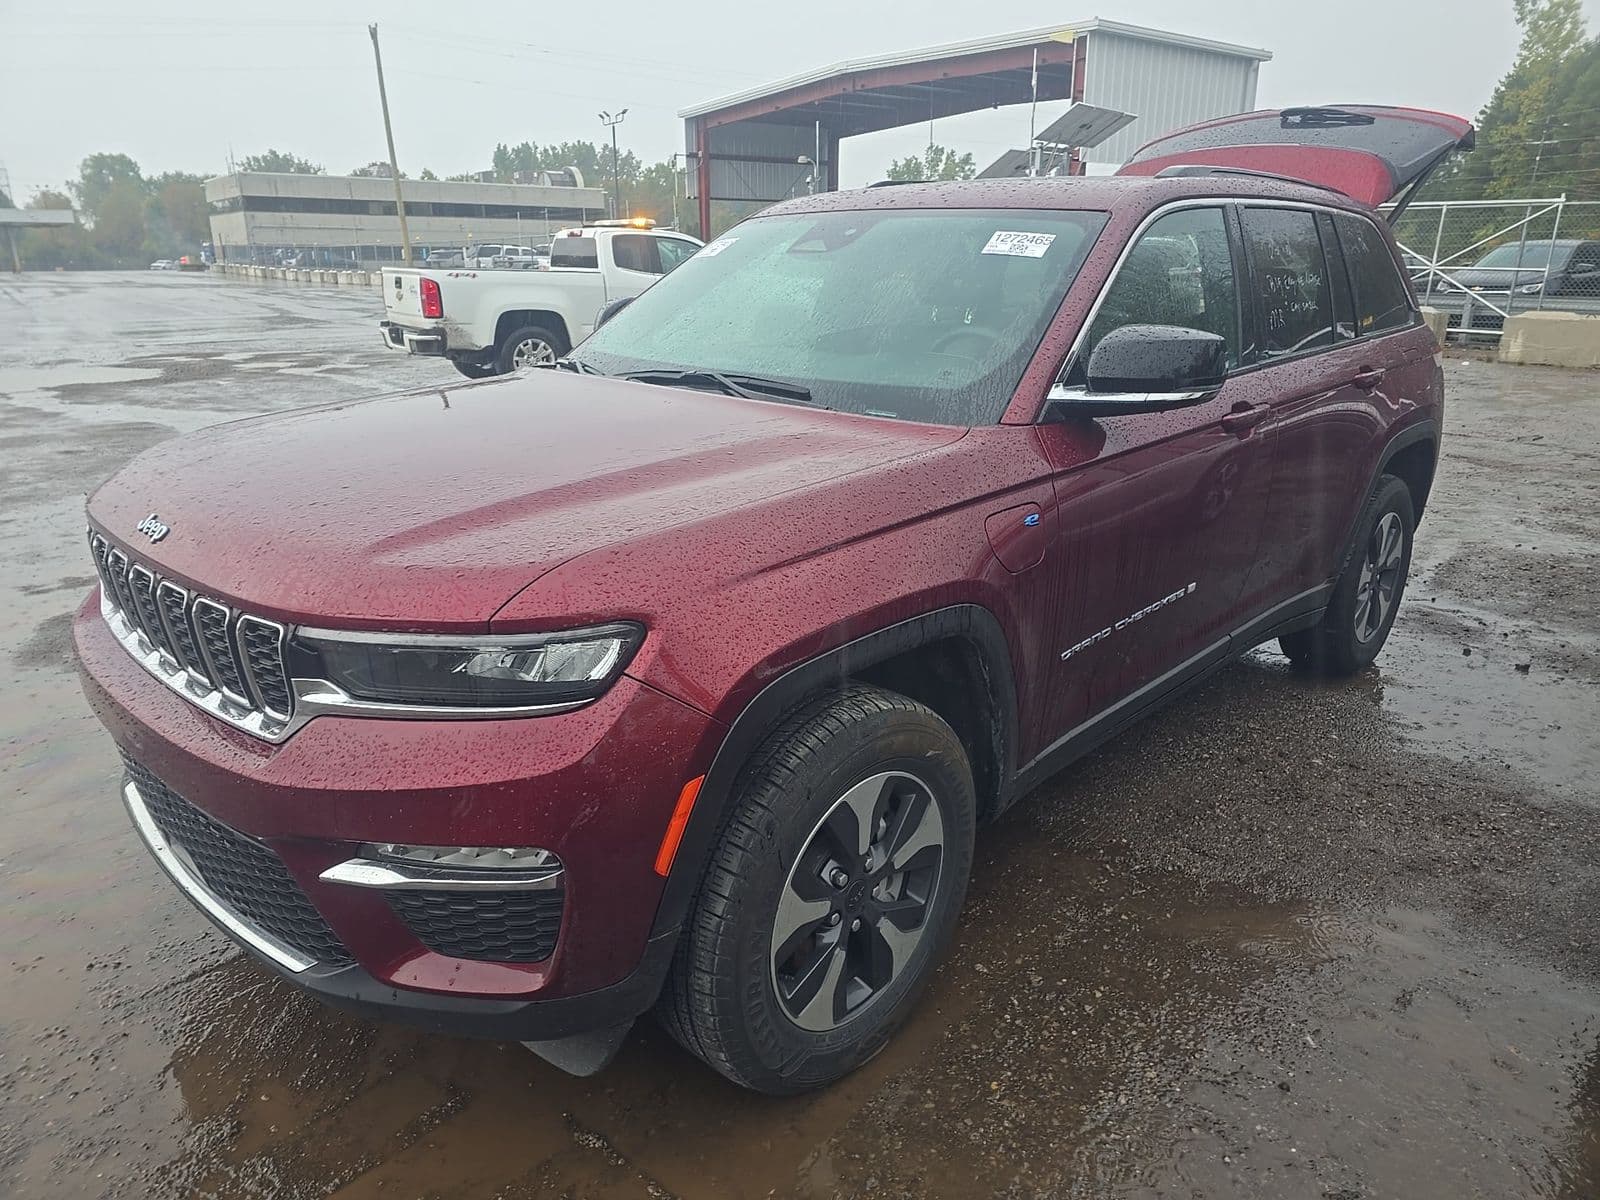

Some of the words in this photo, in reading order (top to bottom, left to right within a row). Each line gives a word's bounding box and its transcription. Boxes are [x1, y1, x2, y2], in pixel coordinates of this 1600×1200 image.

[995, 233, 1054, 246] 1272465
[137, 513, 168, 542] Jeep
[1061, 627, 1112, 661] GRAND
[1114, 588, 1186, 631] CHEROKEE
